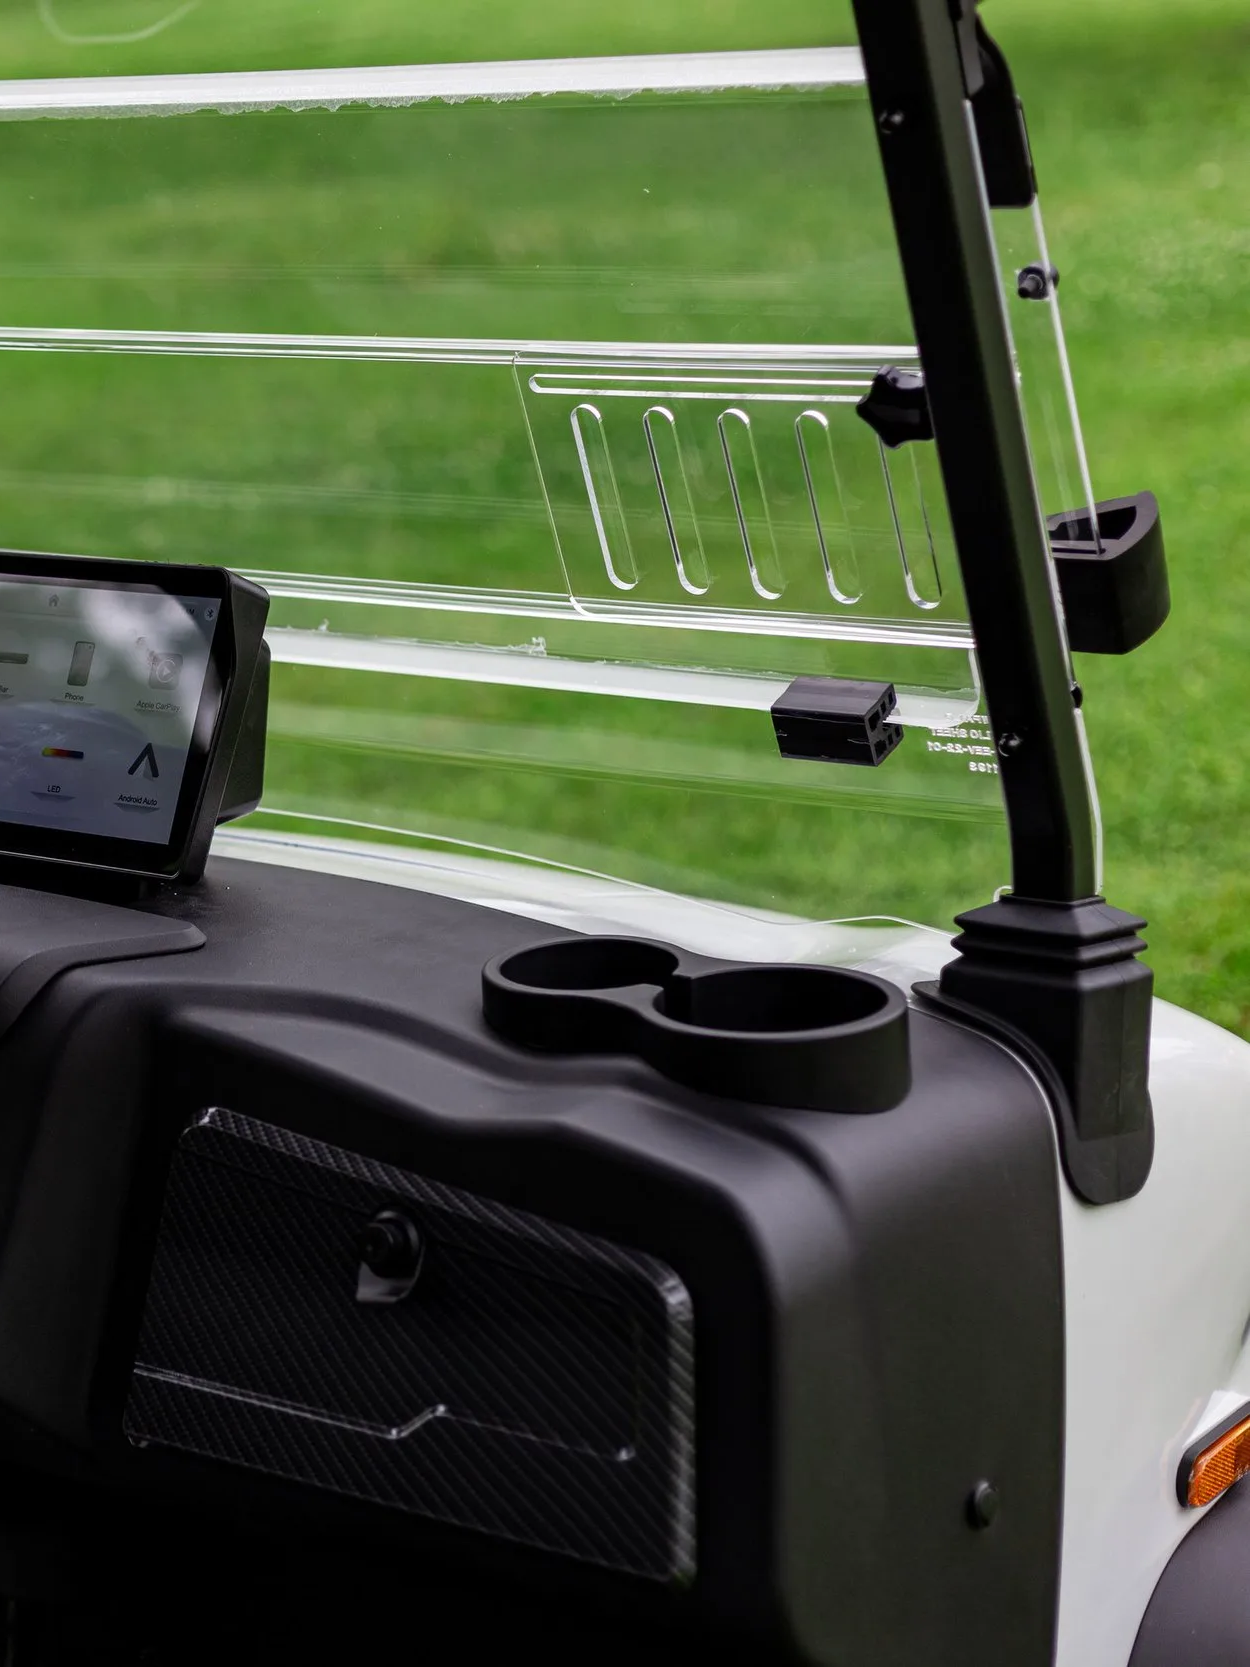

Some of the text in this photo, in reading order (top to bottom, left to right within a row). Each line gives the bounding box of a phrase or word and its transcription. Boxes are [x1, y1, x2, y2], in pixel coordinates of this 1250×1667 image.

[65, 692, 84, 702] Phone
[136, 700, 181, 712] Apple CarPlay
[47, 785, 61, 793] LED
[118, 794, 158, 806] Android Auto
